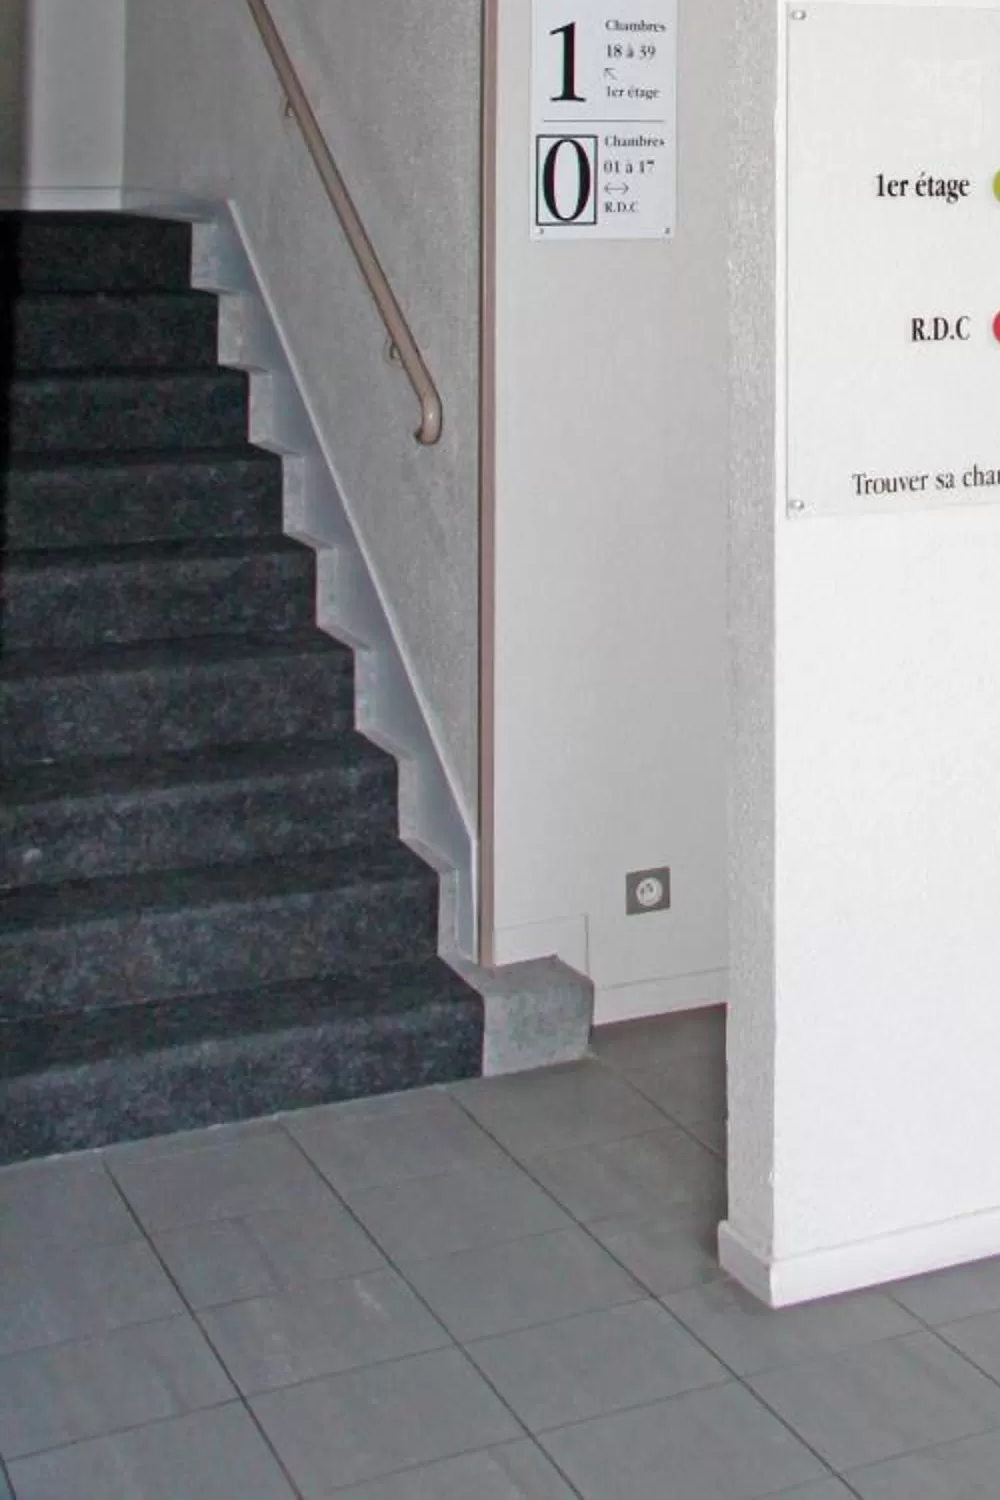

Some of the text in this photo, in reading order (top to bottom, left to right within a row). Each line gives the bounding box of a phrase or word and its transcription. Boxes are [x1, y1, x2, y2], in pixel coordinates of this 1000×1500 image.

[605, 19, 667, 33] Chambres
[549, 21, 587, 102] 1
[606, 44, 657, 61] 18 à 39
[606, 85, 661, 100] 1er étage
[604, 135, 666, 148] Chambres
[603, 159, 655, 174] 01 à 17
[542, 139, 591, 222] 0
[876, 173, 909, 197] 1er
[914, 171, 971, 203] étage
[911, 316, 971, 341] R.D.C
[852, 470, 928, 496] Trouver
[935, 474, 956, 490] sa
